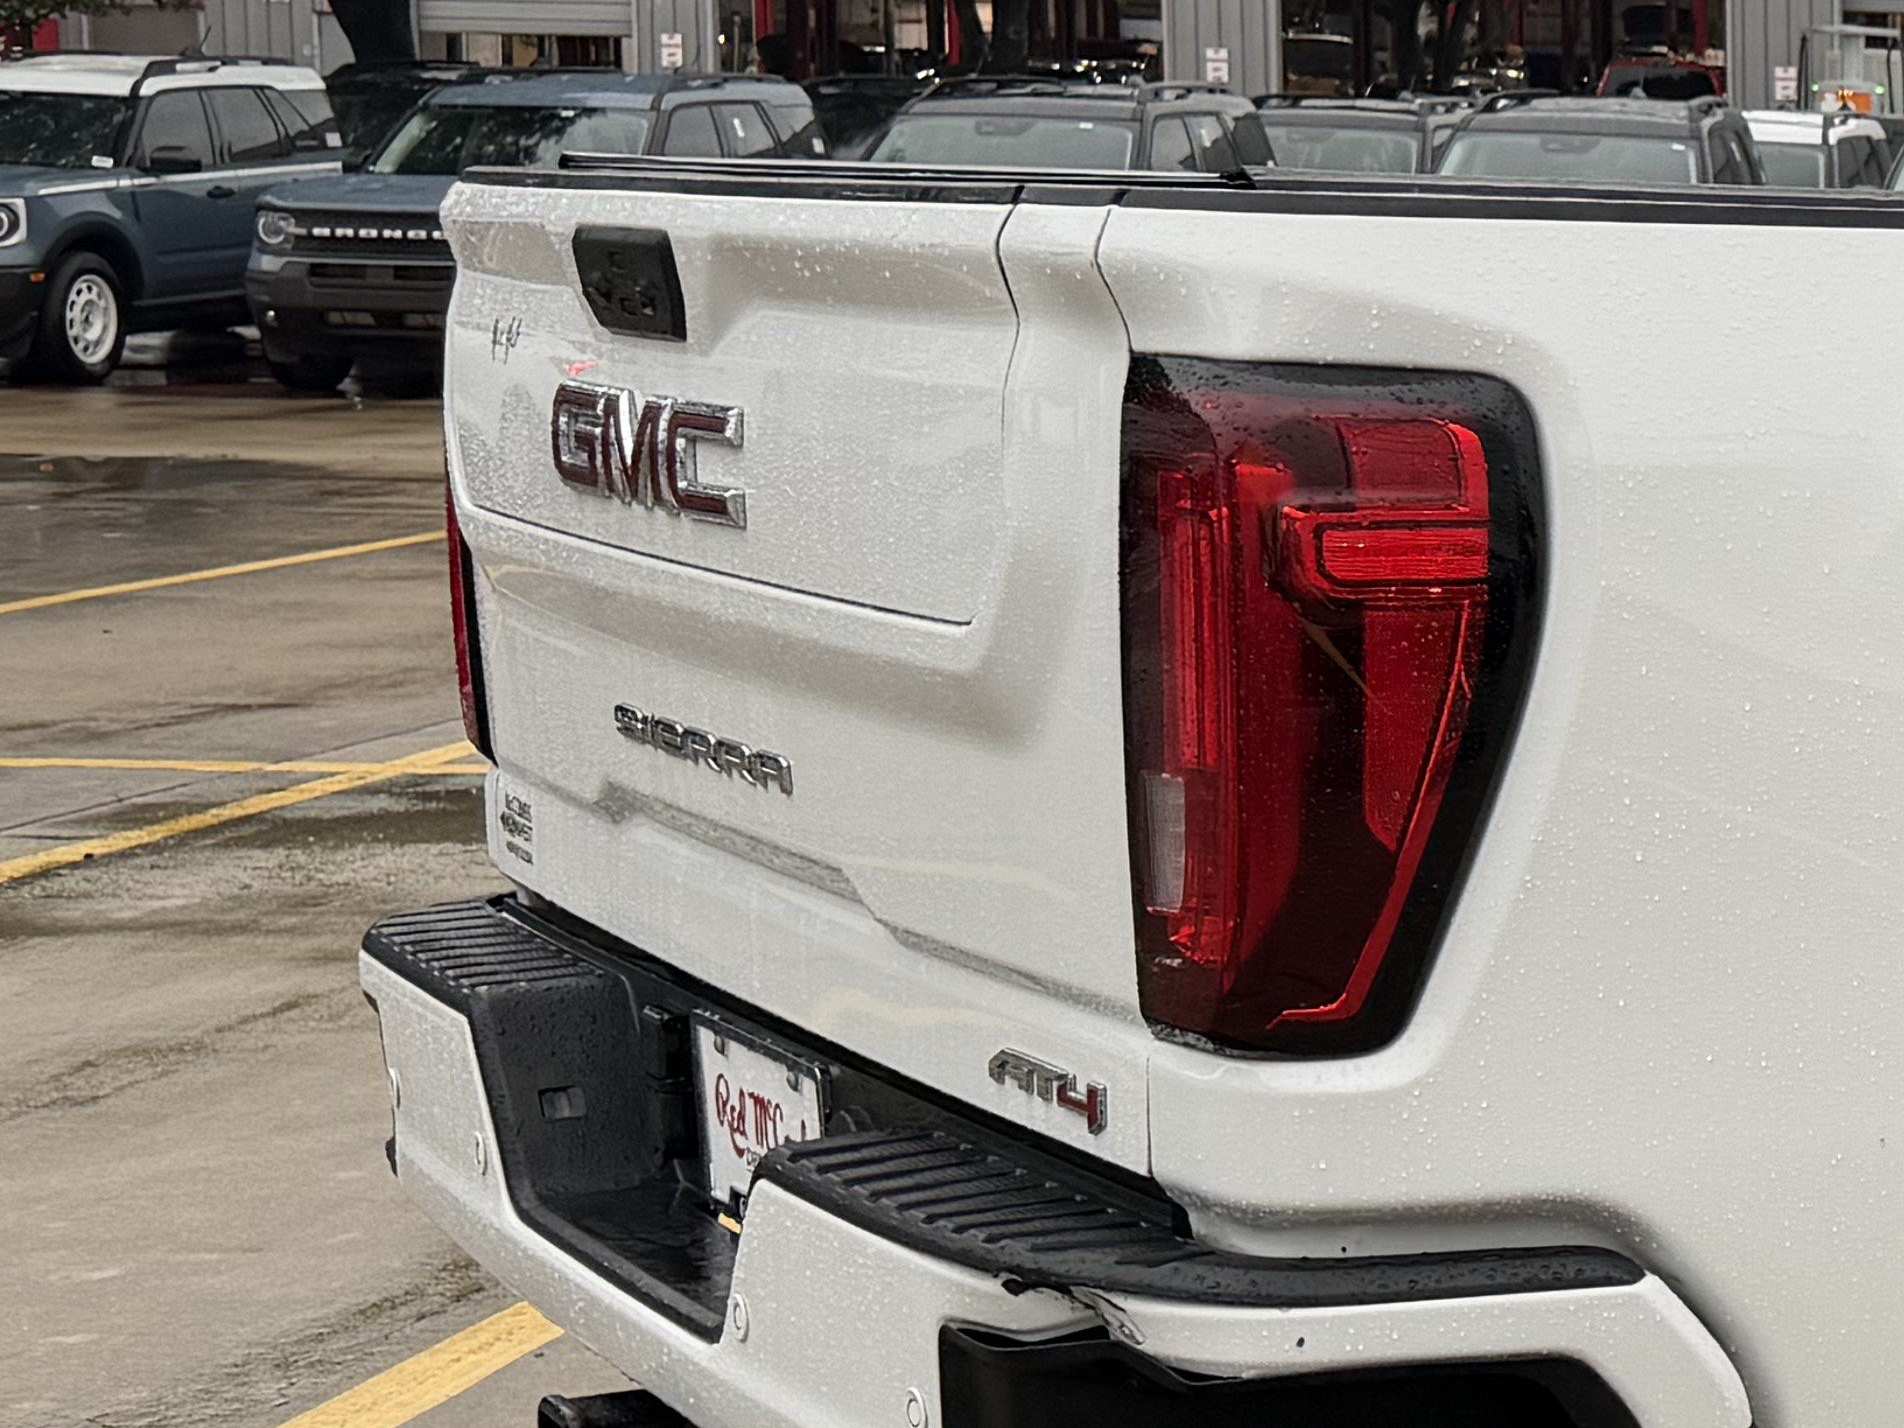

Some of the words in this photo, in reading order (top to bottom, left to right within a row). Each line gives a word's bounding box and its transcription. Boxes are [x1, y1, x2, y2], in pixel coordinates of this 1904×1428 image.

[551, 378, 747, 531] GMC
[613, 702, 793, 797] SIERRA
[715, 1072, 748, 1159] Red
[988, 1047, 1108, 1136] AT4
